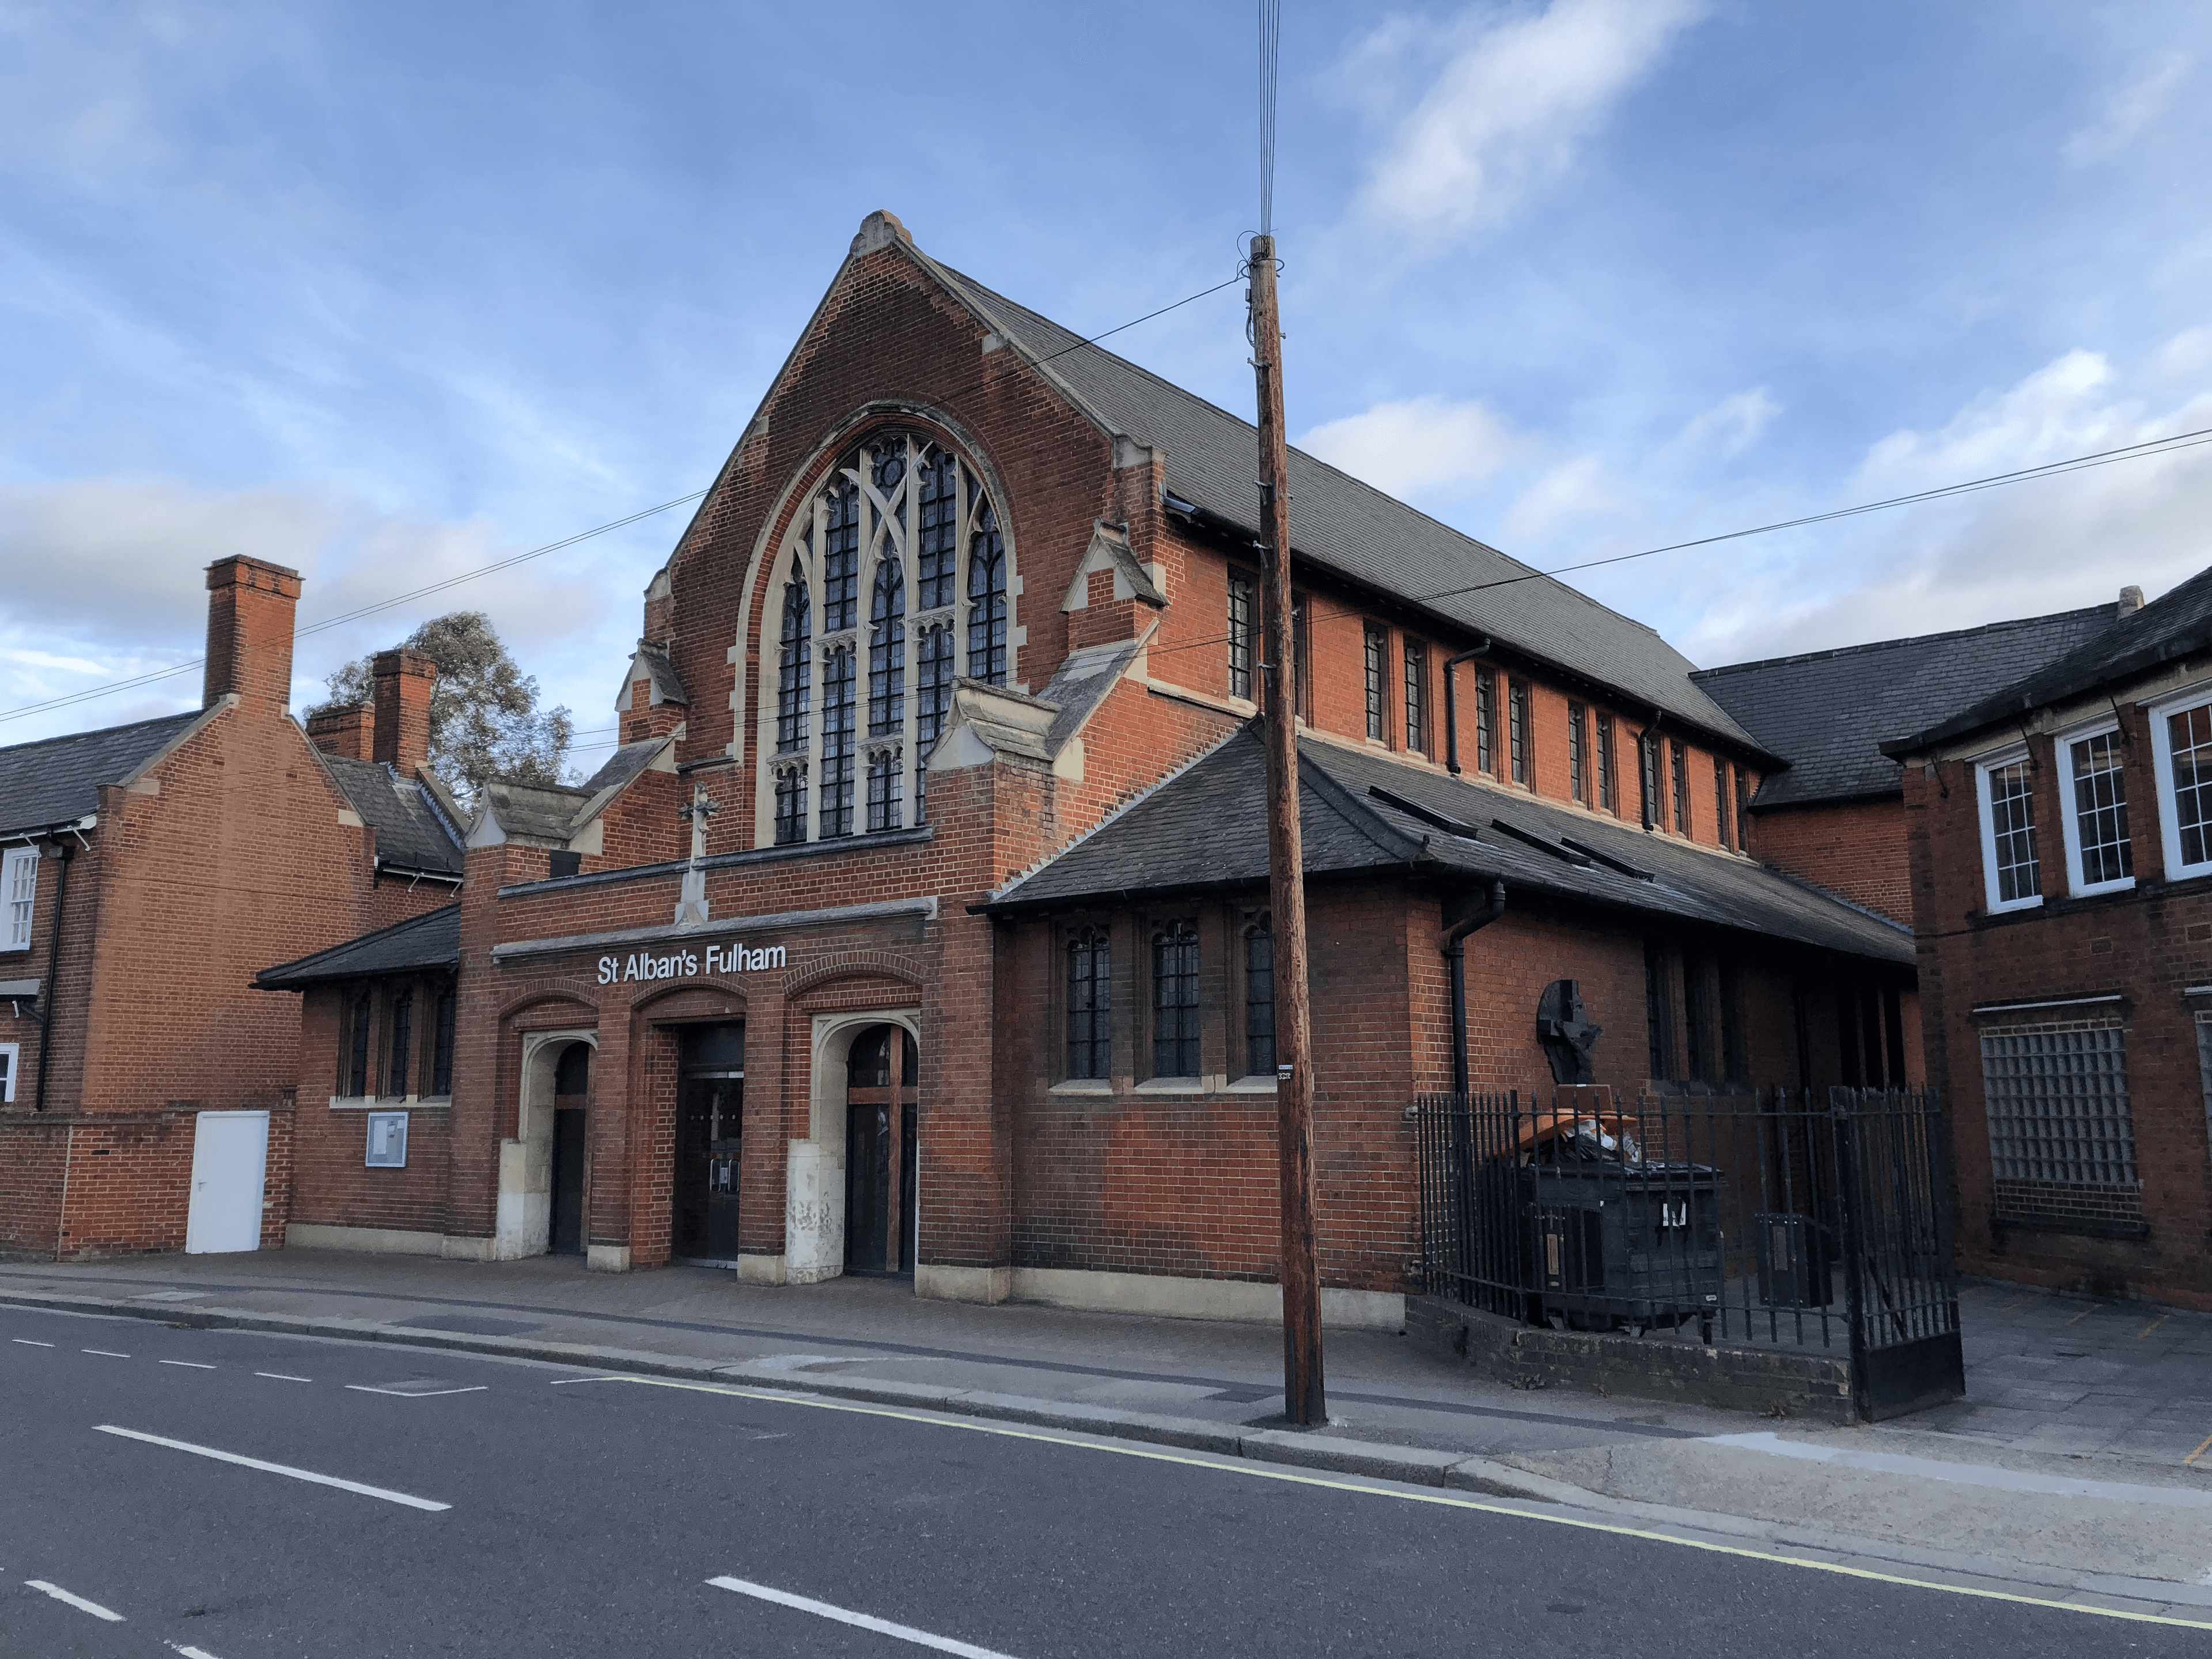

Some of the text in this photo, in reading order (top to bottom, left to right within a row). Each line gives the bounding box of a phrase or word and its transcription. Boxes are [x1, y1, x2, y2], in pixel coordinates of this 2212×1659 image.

[597, 943, 786, 984] St Alban's Fulham
